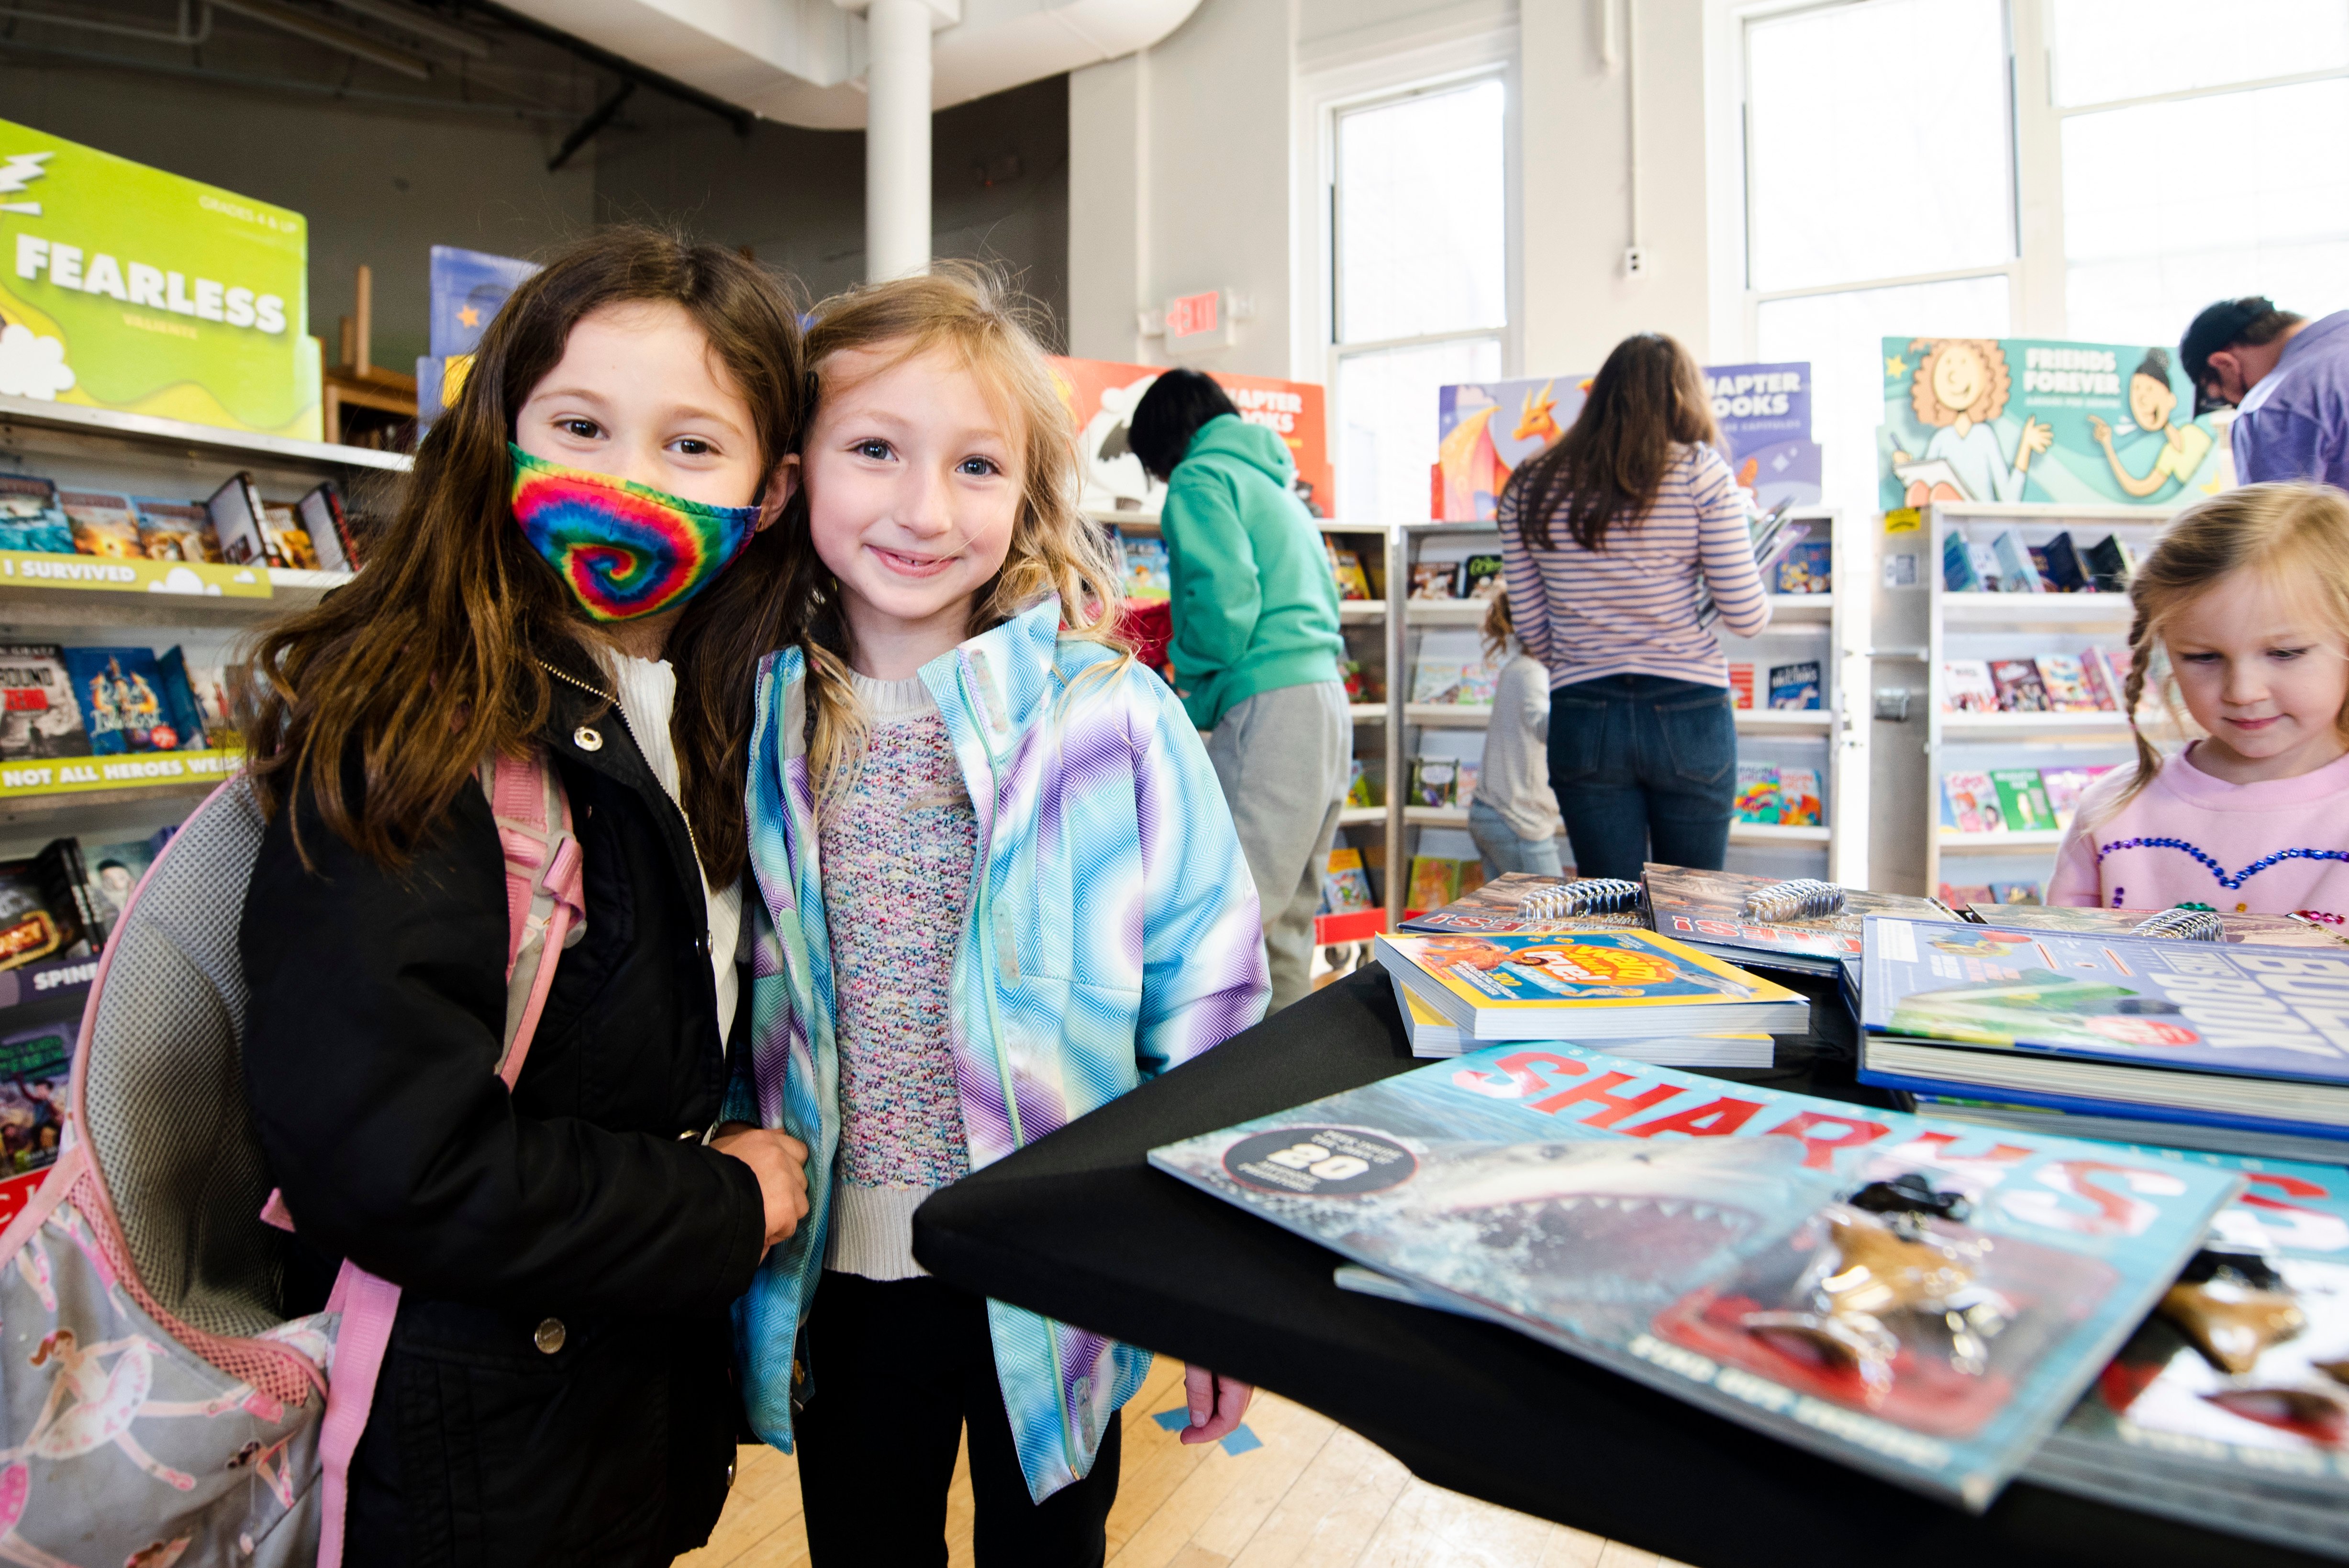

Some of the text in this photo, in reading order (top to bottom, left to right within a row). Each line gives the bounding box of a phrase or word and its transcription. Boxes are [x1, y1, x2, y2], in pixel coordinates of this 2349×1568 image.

[16, 232, 287, 334] FEARLESS
[2026, 347, 2116, 372] FRIENDS
[2023, 370, 2121, 395] FOREVER
[3, 558, 136, 582] I SURVIVED
[2, 769, 52, 788] NOT
[59, 767, 99, 784] ALL
[104, 759, 183, 780] HEROES
[1512, 966, 1567, 990] OCEAN
[1524, 950, 1612, 981] true!
[2148, 971, 2343, 1059] BOOK
[1683, 1075, 1783, 1103] YOUR
[1266, 1143, 1370, 1180] 20
